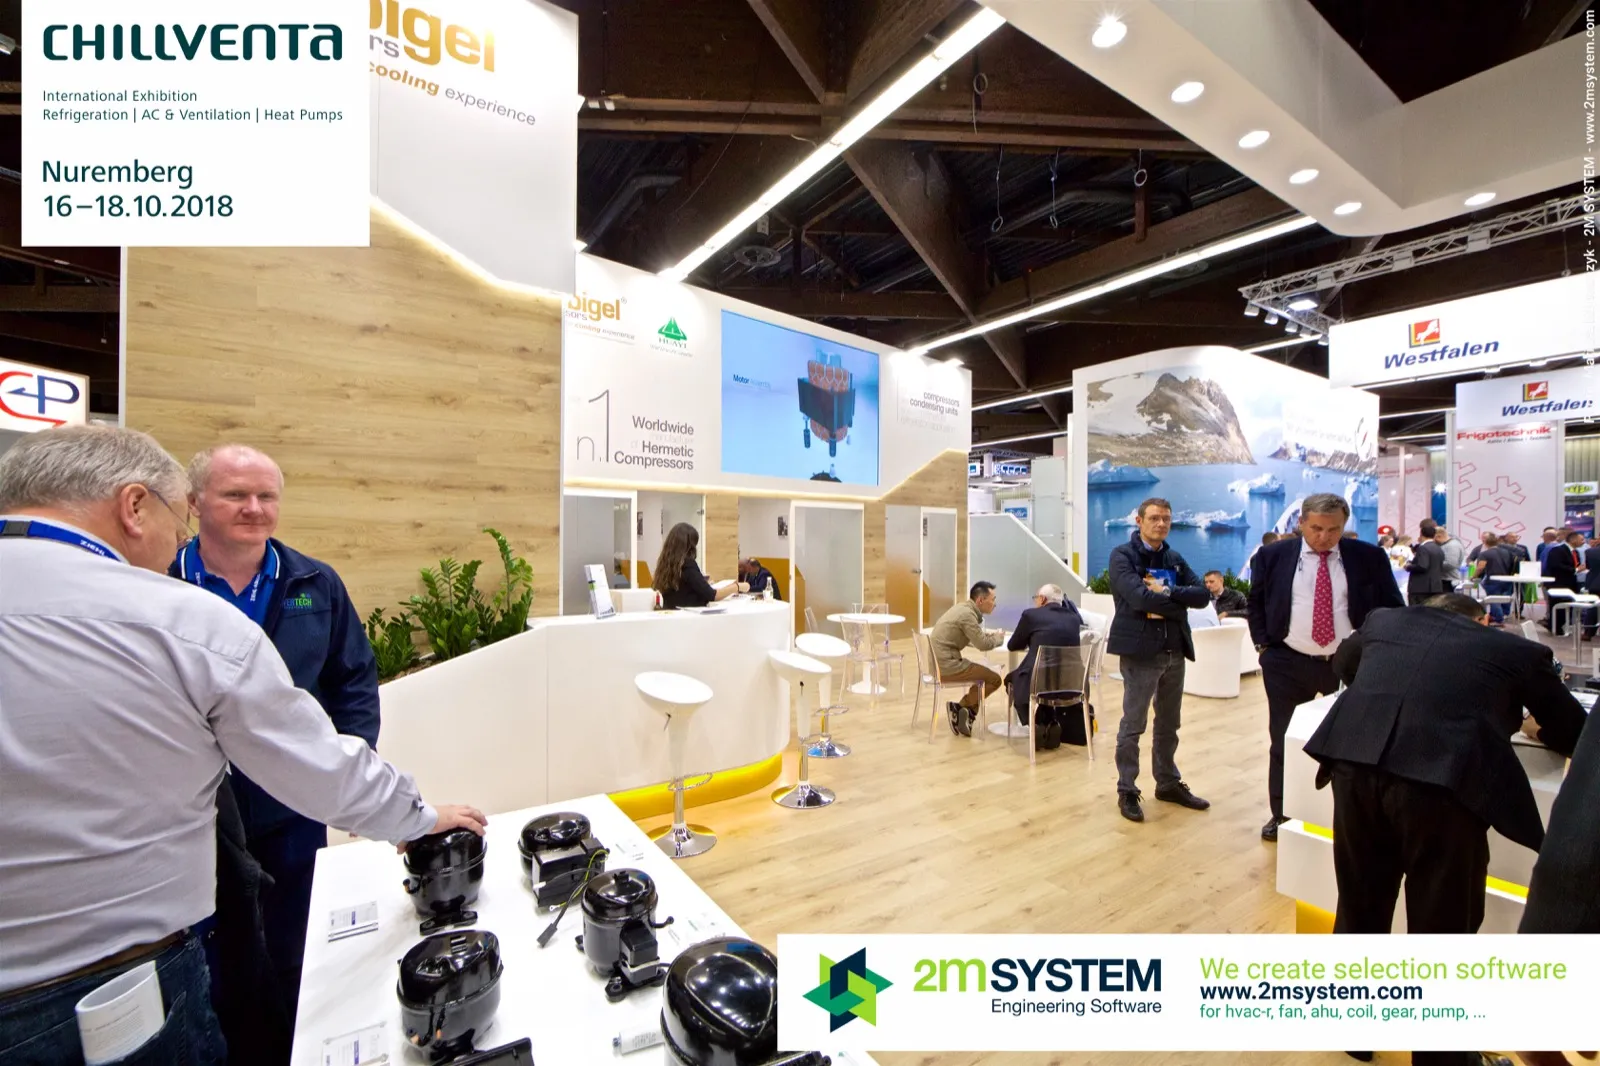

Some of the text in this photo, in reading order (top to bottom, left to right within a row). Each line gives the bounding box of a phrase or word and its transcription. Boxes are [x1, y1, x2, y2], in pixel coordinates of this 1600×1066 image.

[445, 86, 536, 126] experience
[1383, 339, 1500, 370] Westfalen
[733, 374, 750, 384] Motor
[909, 398, 945, 415] condensing
[945, 406, 959, 416] units
[923, 391, 960, 408] compressors
[632, 415, 694, 435] Worldwide
[1457, 426, 1551, 441] Frigotechnik
[642, 440, 694, 458] Hermetic
[614, 450, 694, 471] Compressors
